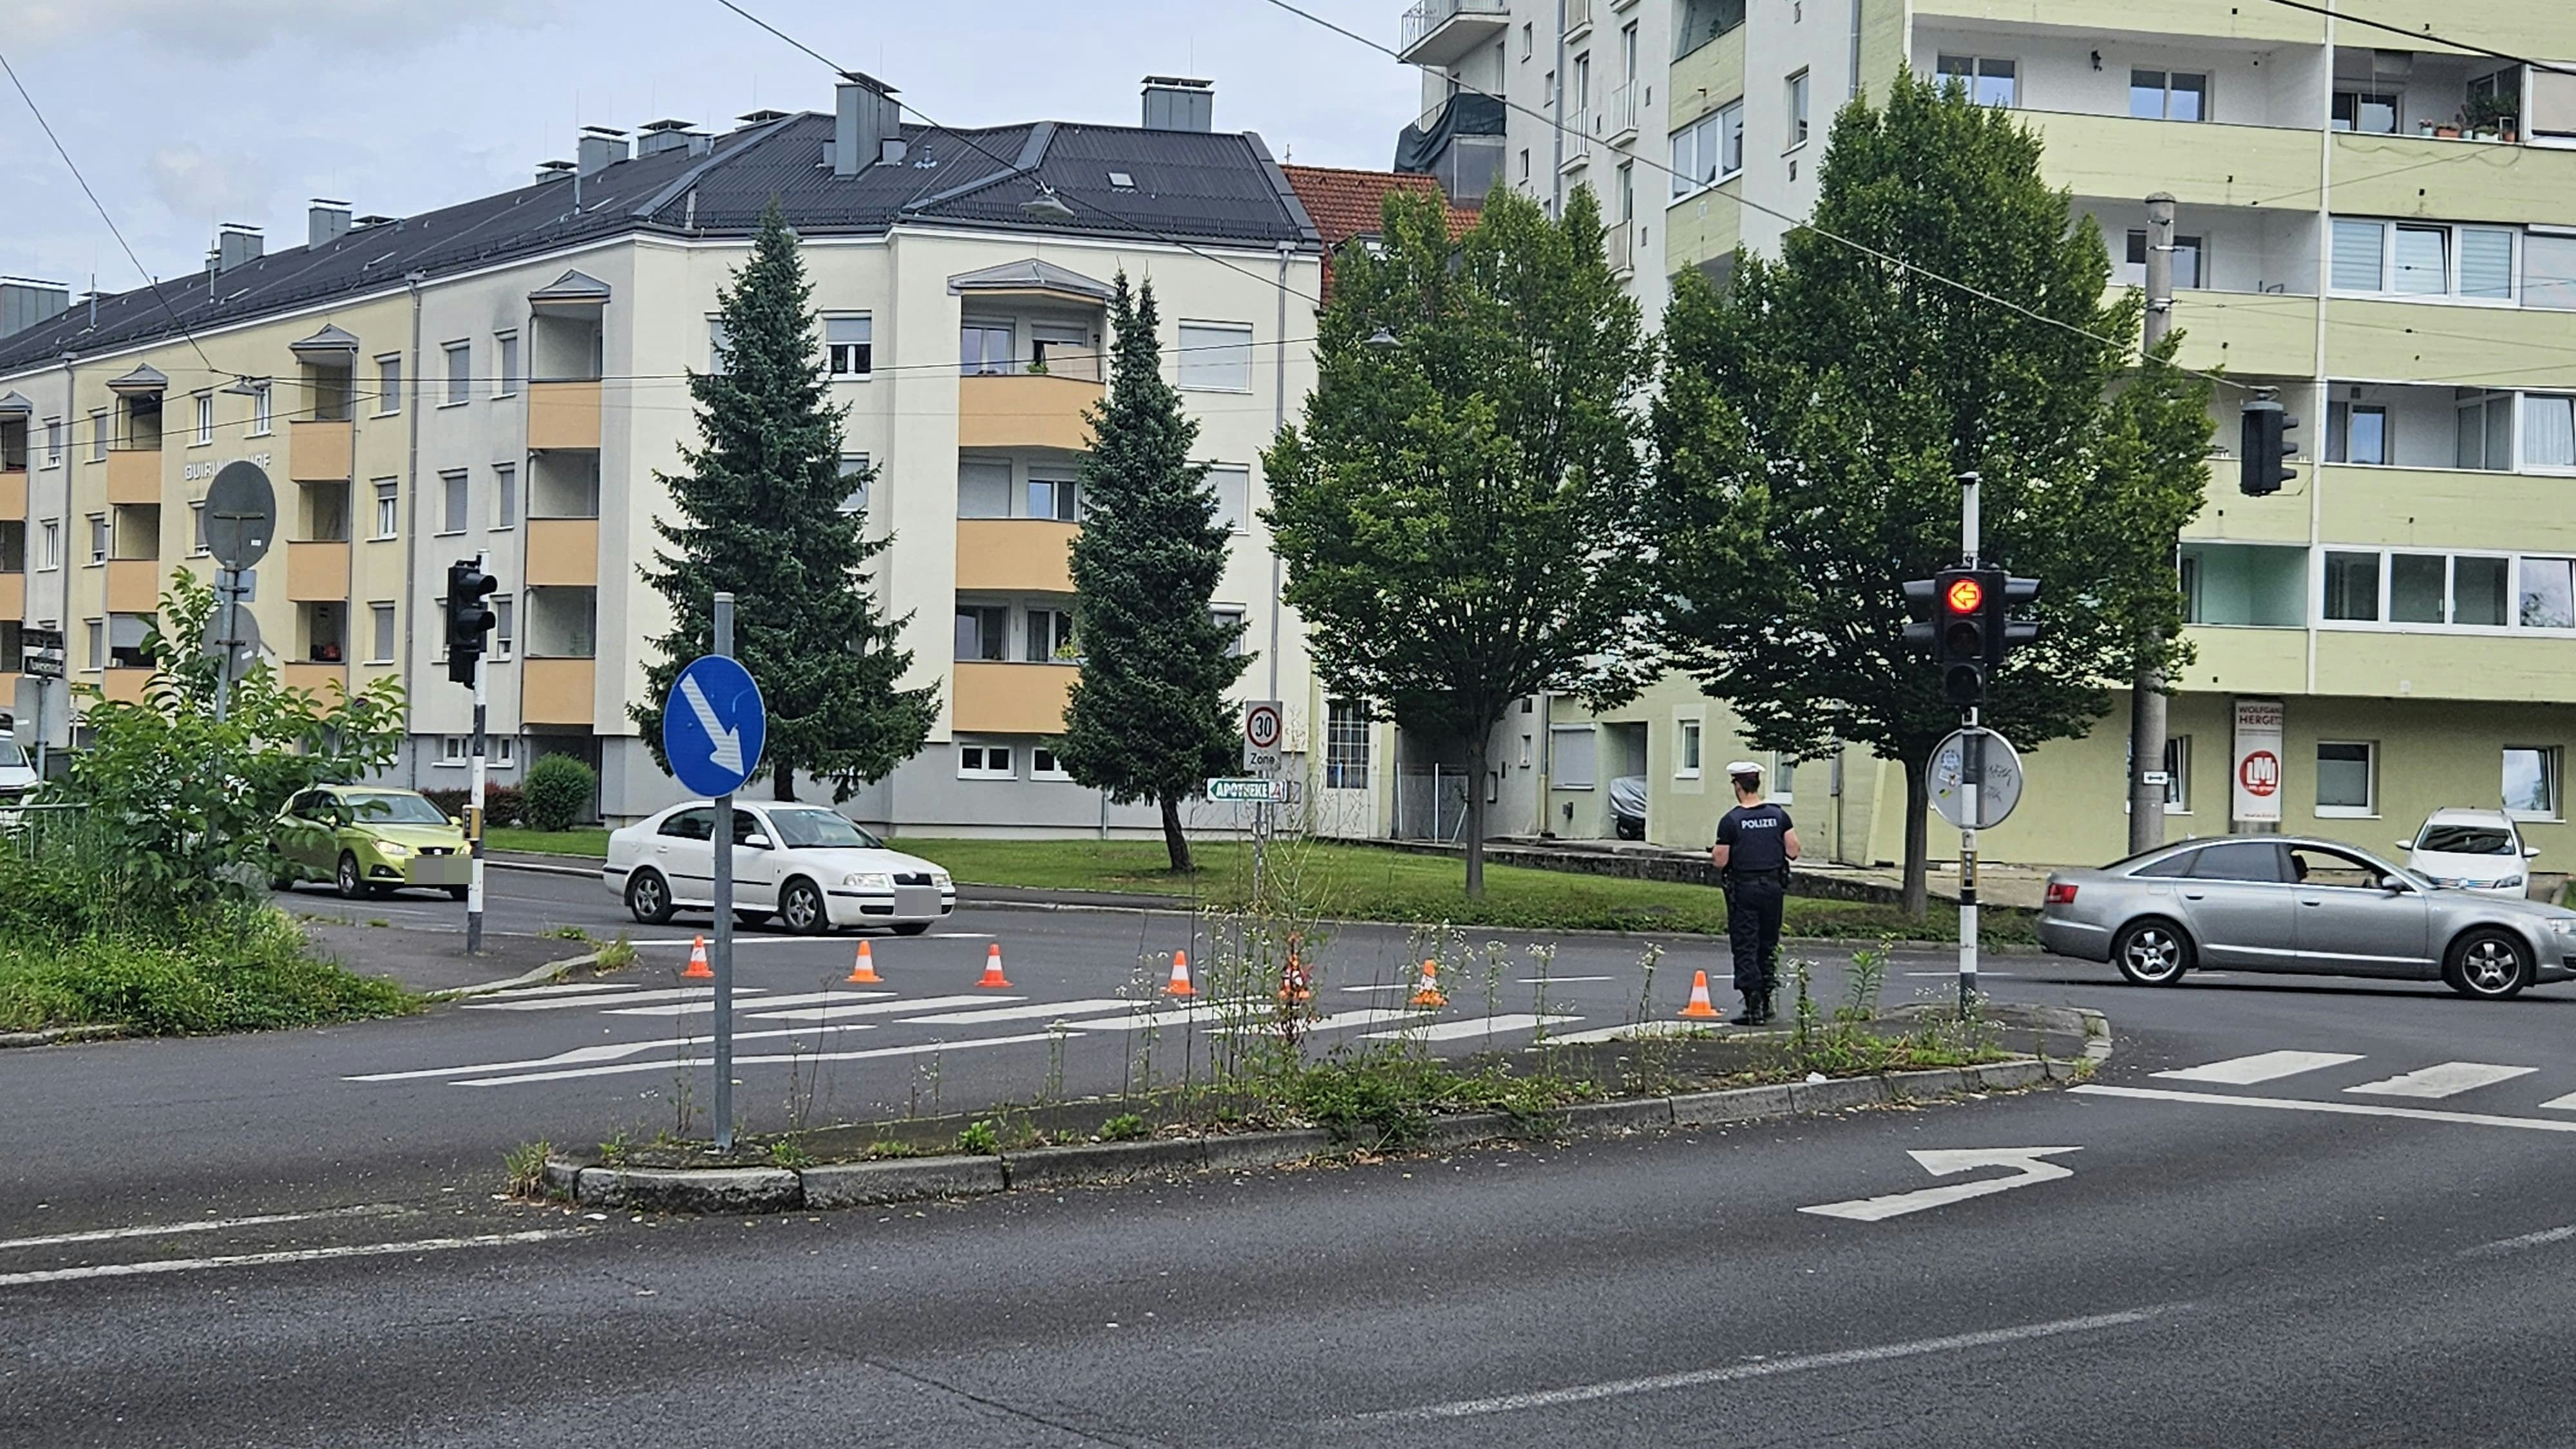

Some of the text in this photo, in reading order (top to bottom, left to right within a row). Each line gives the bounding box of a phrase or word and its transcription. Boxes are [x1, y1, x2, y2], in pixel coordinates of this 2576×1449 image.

[1255, 716, 1272, 737] 30
[1251, 753, 1275, 765] Zone
[1216, 782, 1267, 797] APOTHEKE
[1741, 819, 1777, 829] POLIZEI
